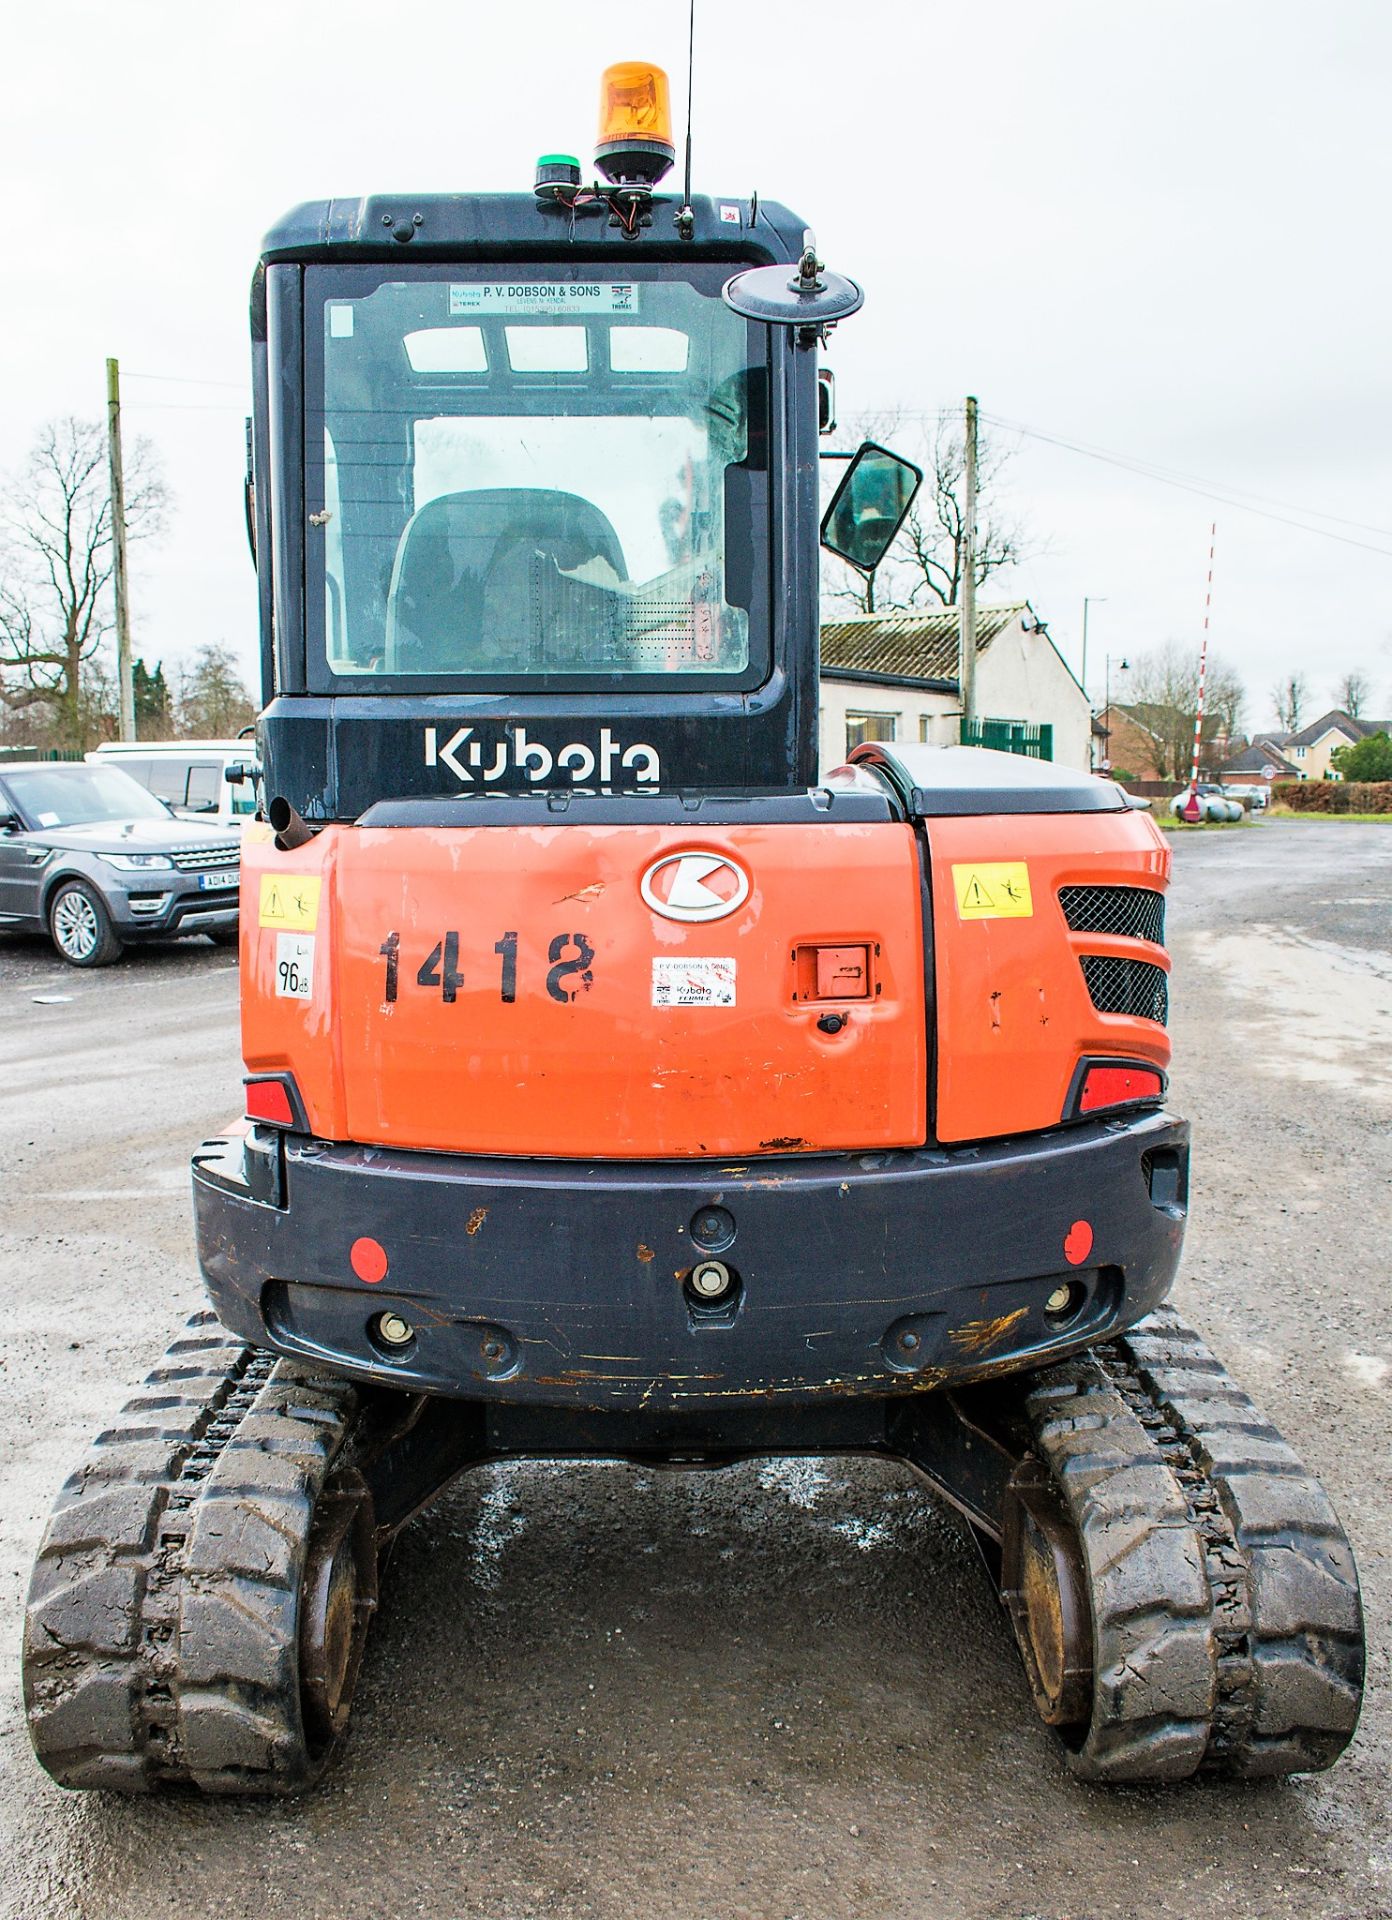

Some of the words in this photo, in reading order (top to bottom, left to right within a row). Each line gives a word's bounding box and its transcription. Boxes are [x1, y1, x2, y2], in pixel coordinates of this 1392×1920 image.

[483, 286, 493, 297] P.
[495, 286, 505, 297] V.
[507, 286, 555, 297] DOBSON
[558, 286, 567, 297] &
[569, 286, 601, 297] SONS
[425, 727, 660, 782] Kubota
[279, 961, 298, 992] 96
[379, 930, 595, 1003] 1418
[677, 986, 712, 995] Kubota
